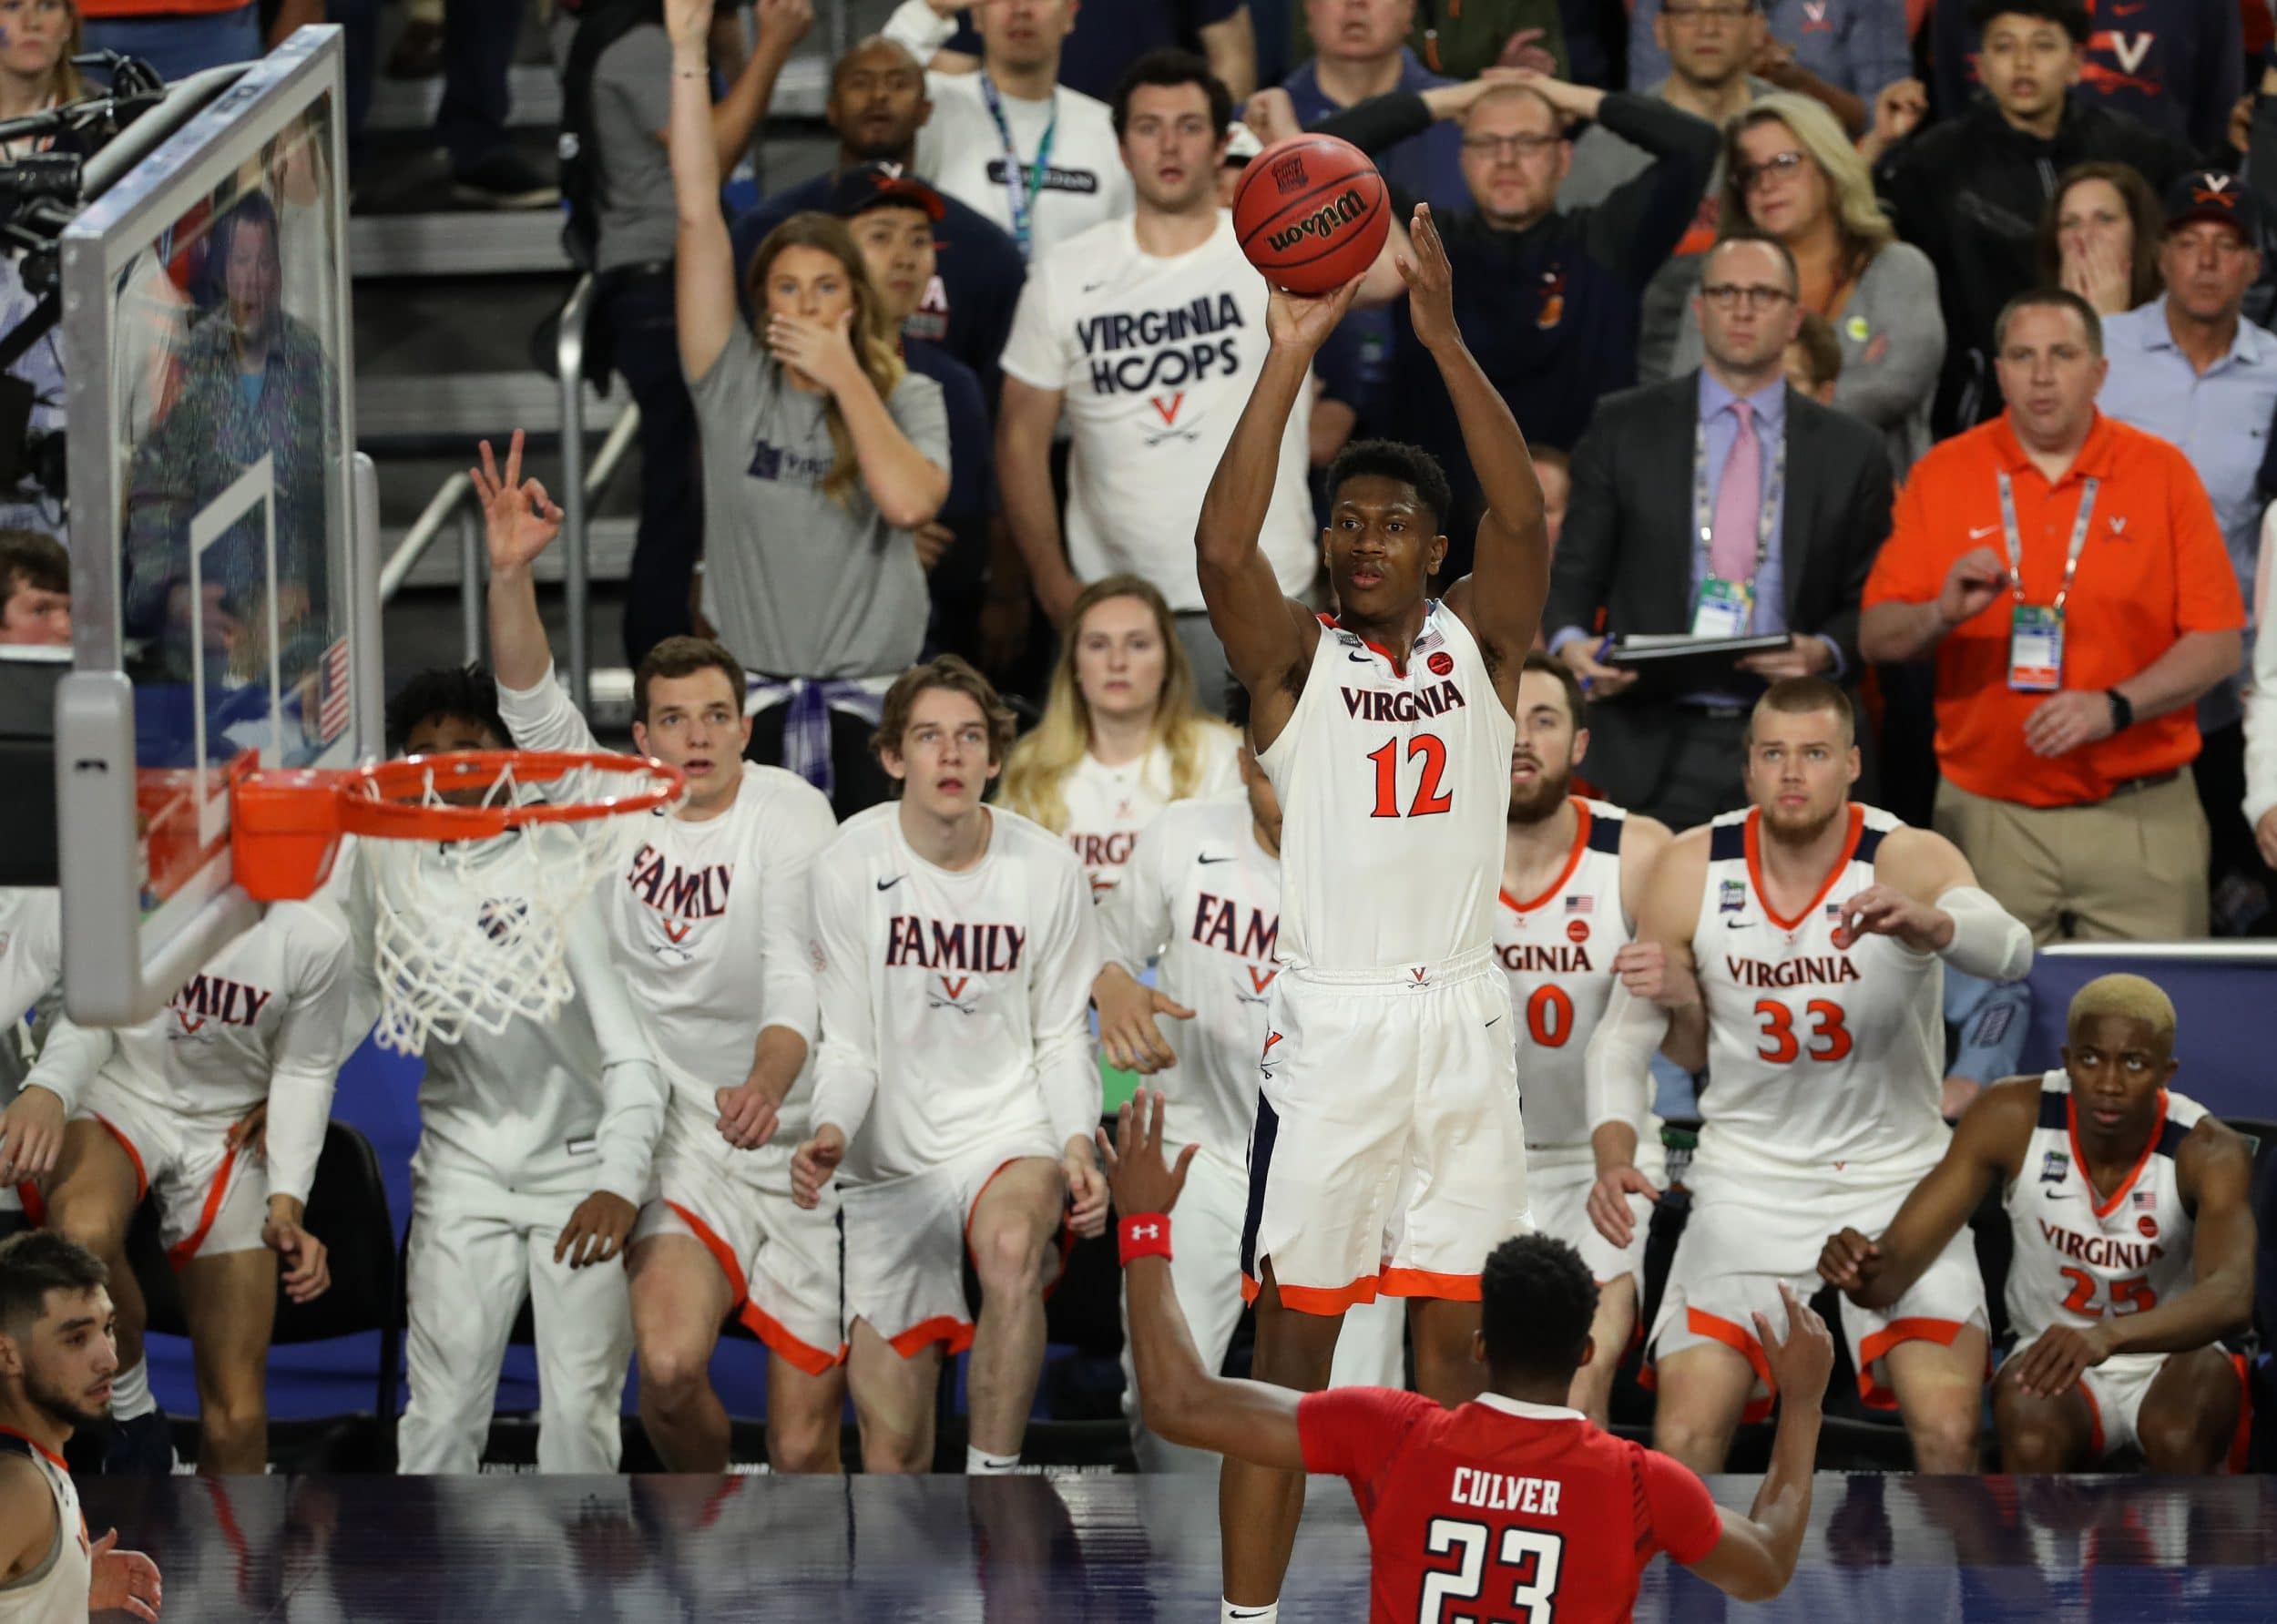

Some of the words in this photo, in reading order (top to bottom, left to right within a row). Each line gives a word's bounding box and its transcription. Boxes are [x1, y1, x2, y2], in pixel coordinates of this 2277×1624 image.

[2110, 30, 2155, 74] V
[2204, 173, 2230, 194] V
[1266, 189, 1368, 252] Wilson
[1077, 292, 1245, 356] VIRGINIA
[1090, 338, 1238, 395] HOOPS
[1151, 392, 1184, 426] V
[1340, 679, 1466, 722] VIRGNIA
[1367, 733, 1454, 818] 12
[885, 914, 1026, 973] FAMILY
[1191, 891, 1281, 965] FAM
[1494, 944, 1594, 973] GINIA
[1726, 954, 1863, 988] VIRGINIA
[170, 974, 271, 1026] MILY
[940, 975, 968, 1000] V
[1527, 983, 1575, 1049] 0
[1753, 998, 1853, 1064] 33
[2037, 1216, 2165, 1271] VIRGINIA
[2058, 1264, 2158, 1318] 25
[1451, 1466, 1561, 1517] CULVER
[1416, 1515, 1567, 1624] 23
